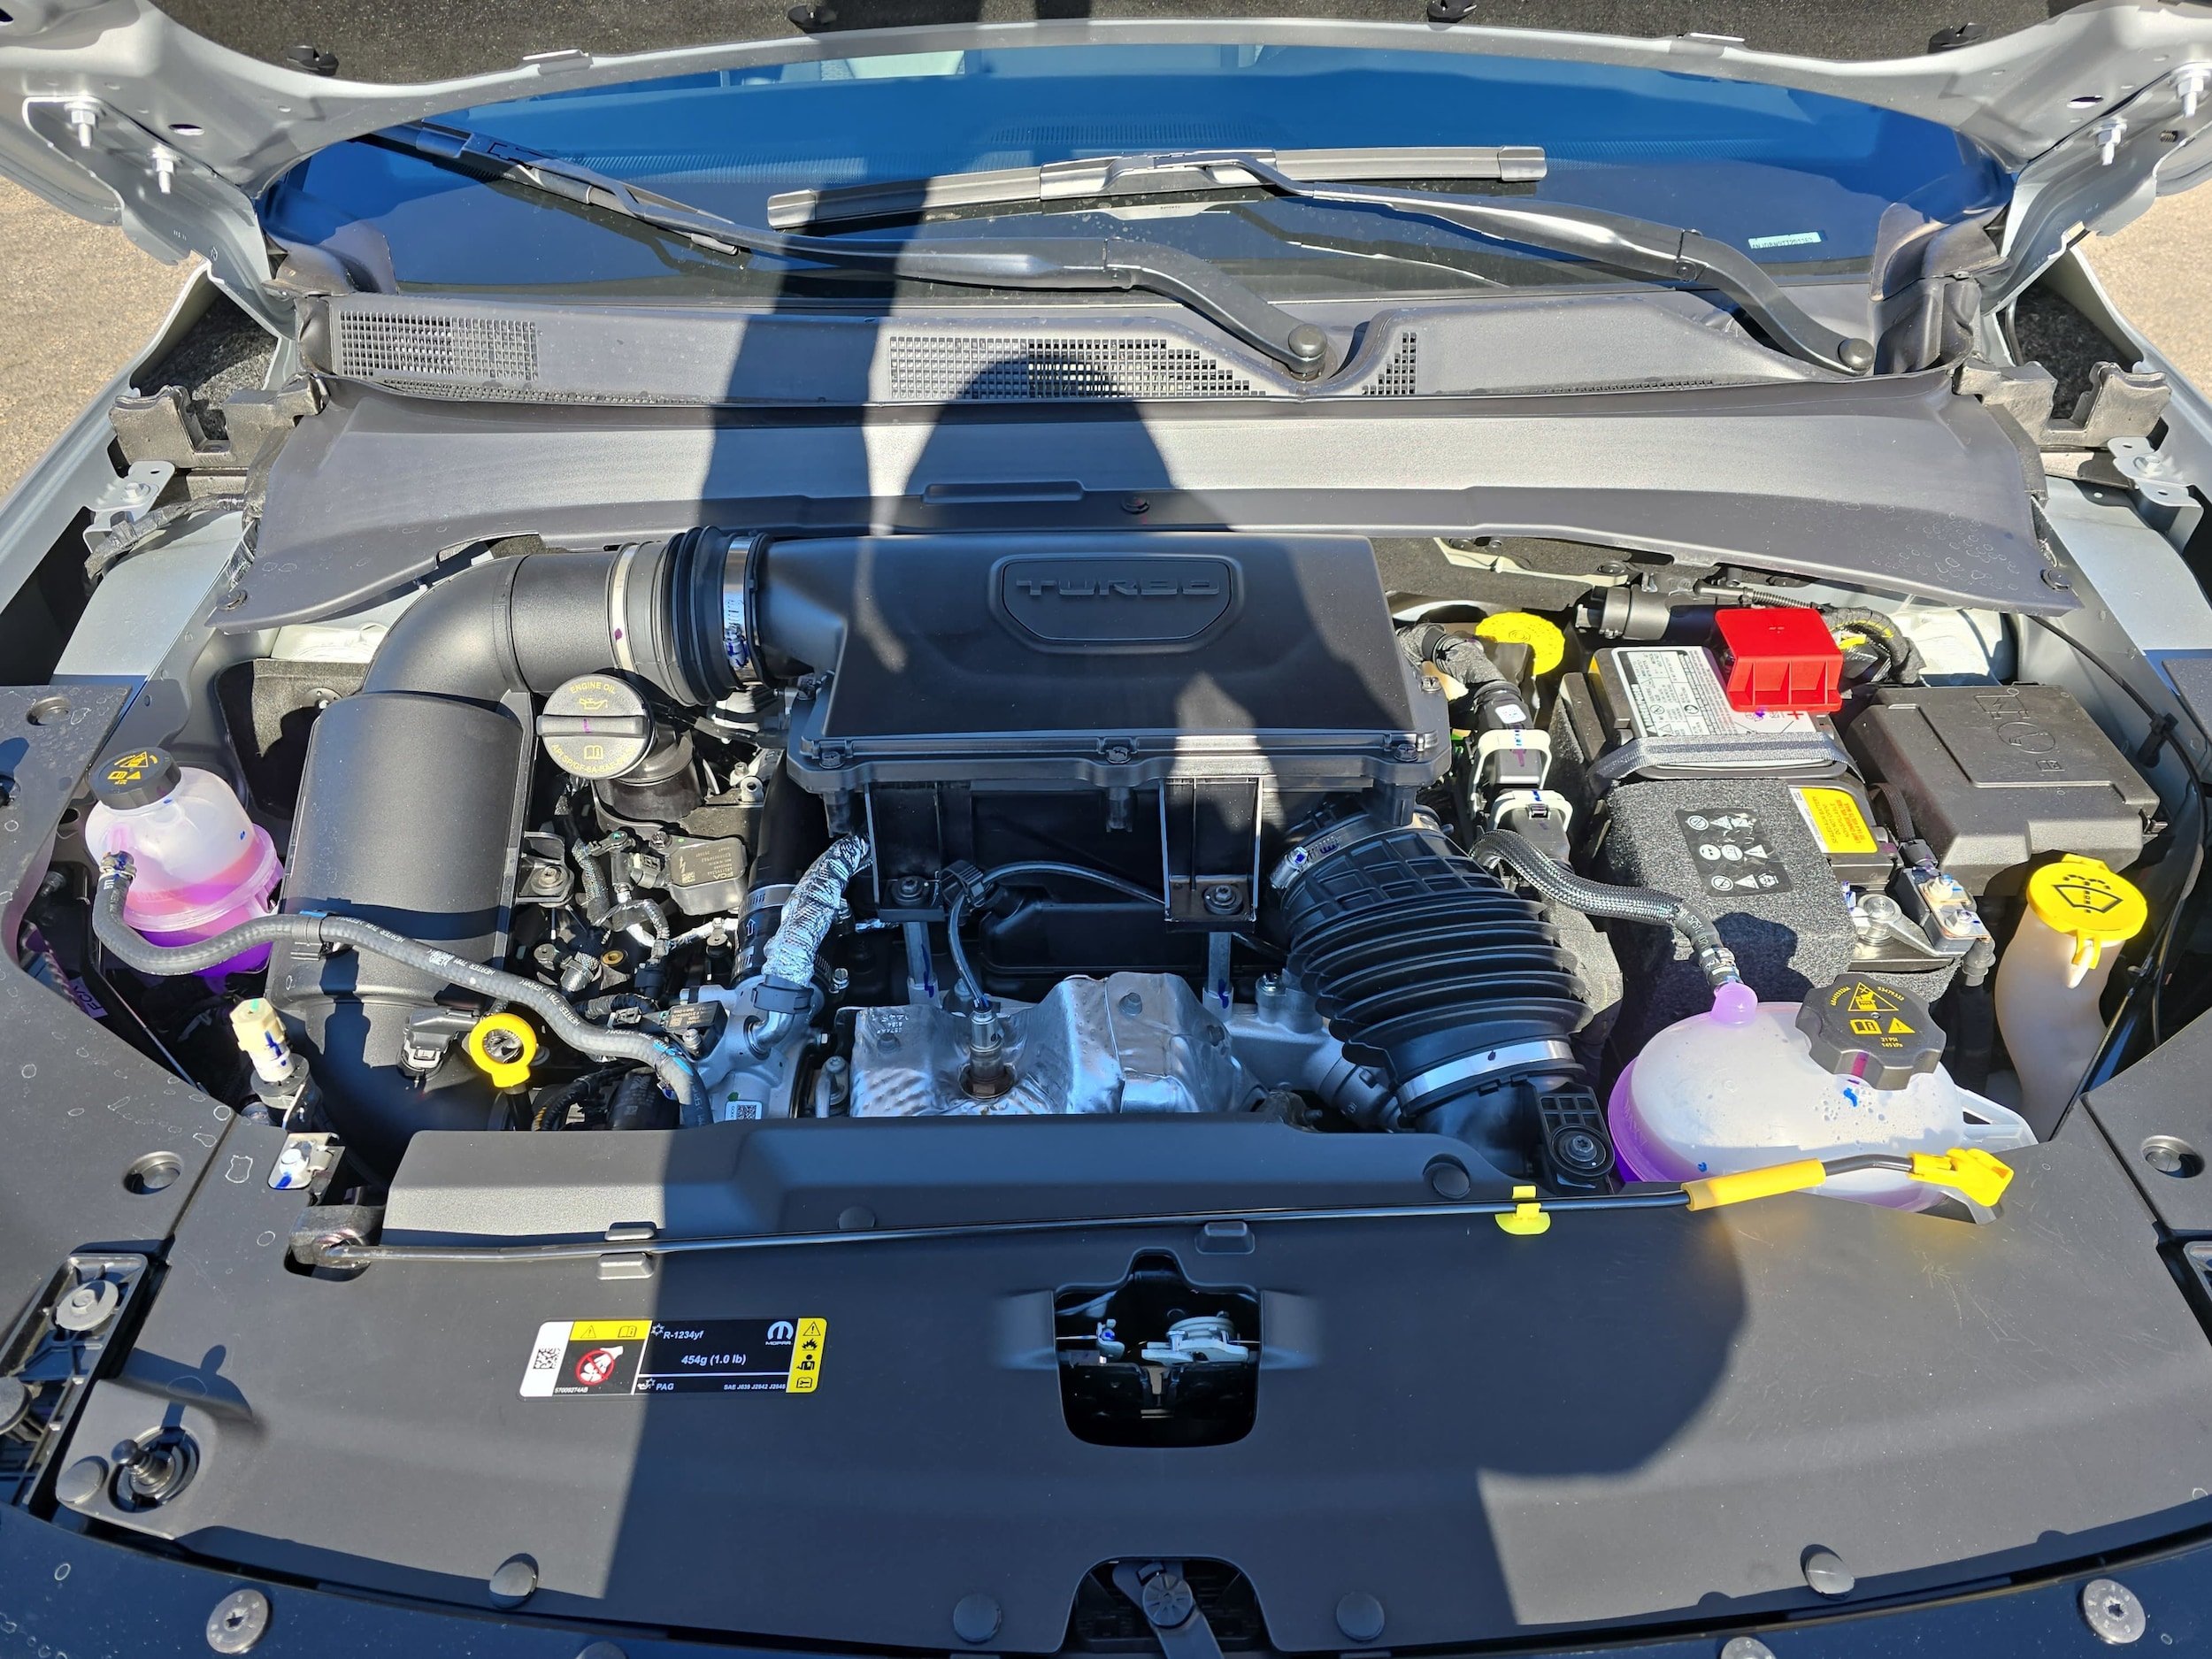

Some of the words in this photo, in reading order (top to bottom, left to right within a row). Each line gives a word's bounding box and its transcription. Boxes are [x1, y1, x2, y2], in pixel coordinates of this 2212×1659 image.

[1016, 578, 1220, 595] TURBO
[569, 681, 602, 694] ENGINE
[603, 683, 616, 694] OIL
[551, 743, 562, 757] API
[469, 961, 495, 977] HEATER
[558, 1004, 581, 1027] HEATER
[663, 1329, 704, 1341] R-1234yf
[681, 1355, 707, 1366] 454g
[710, 1354, 730, 1366] (1.0
[732, 1353, 747, 1366] lb)
[656, 1382, 674, 1391] PAG
